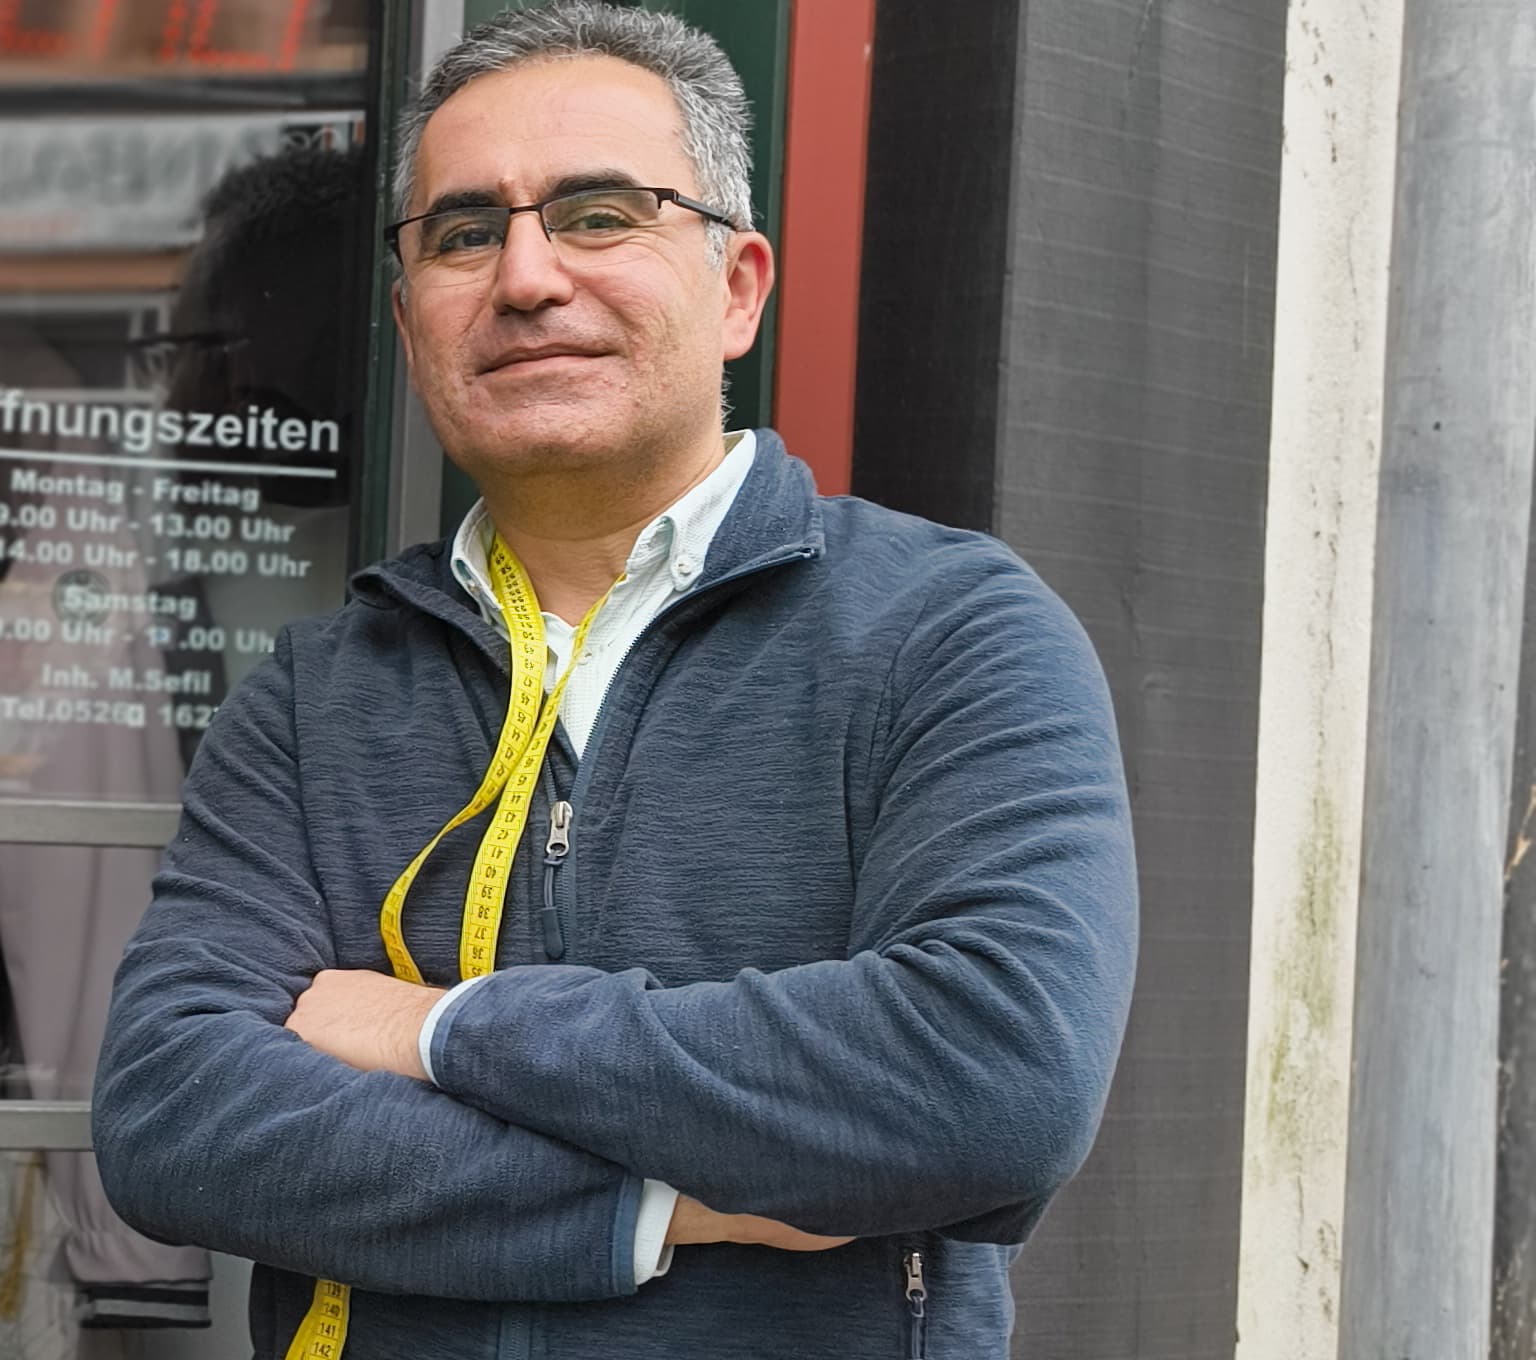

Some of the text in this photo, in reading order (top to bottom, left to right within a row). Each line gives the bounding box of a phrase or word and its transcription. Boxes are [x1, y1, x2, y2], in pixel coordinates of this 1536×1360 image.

[11, 468, 124, 504] Montag
[153, 477, 261, 513] Freitag
[67, 508, 121, 533] Uhr
[151, 513, 232, 539] 13.00
[241, 517, 296, 543] Uhr
[84, 544, 138, 568] Uhr
[166, 548, 248, 574] 18.00
[258, 553, 312, 577] Uhr
[64, 584, 198, 622] Samstag
[61, 620, 116, 646] Uhr
[235, 628, 275, 654] Uh
[42, 663, 98, 689] Inh.
[158, 703, 220, 728] 162
[480, 885, 493, 899] 39
[477, 905, 490, 920] 38
[474, 927, 487, 940] 37
[472, 946, 484, 960] 36
[320, 1322, 337, 1338] 141
[314, 1342, 331, 1358] 142
